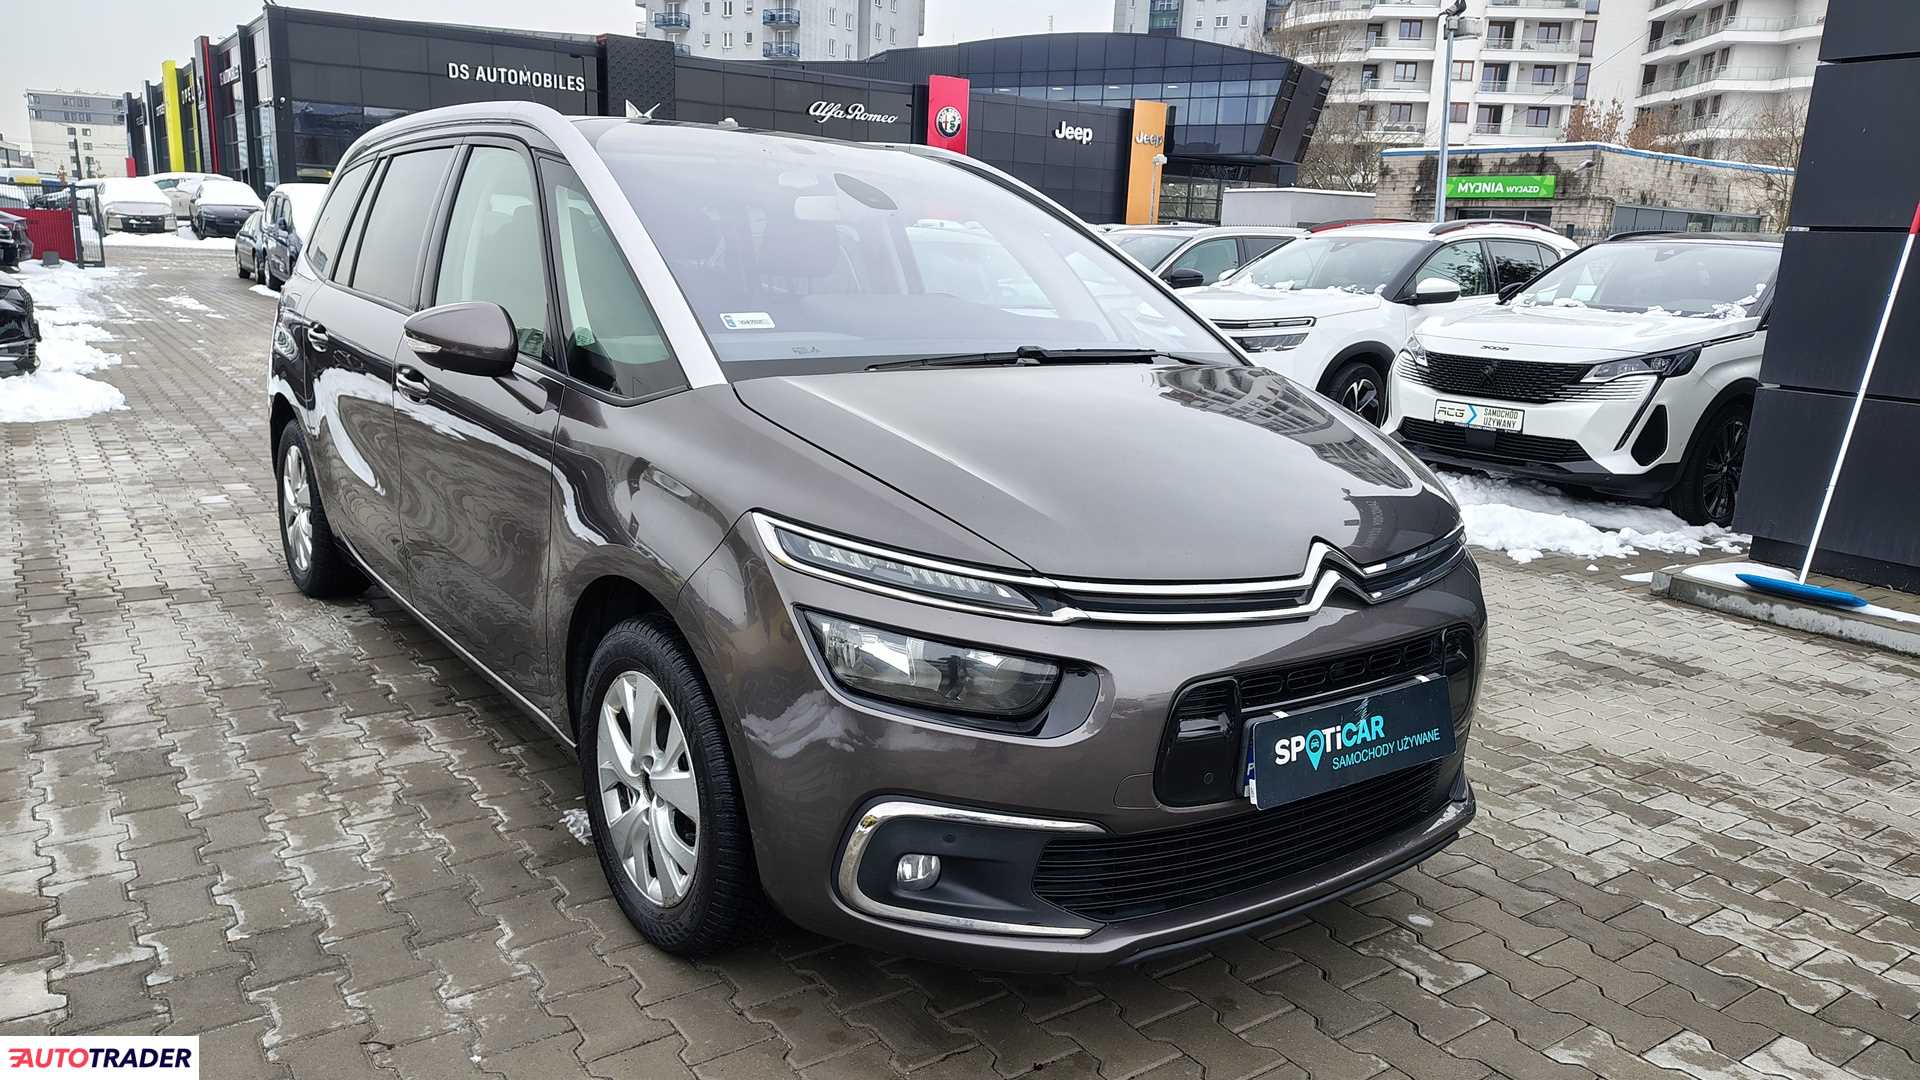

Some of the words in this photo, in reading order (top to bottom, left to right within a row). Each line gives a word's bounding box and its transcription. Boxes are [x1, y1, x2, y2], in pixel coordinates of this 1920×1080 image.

[448, 62, 470, 80] DS
[475, 65, 585, 92] AUTOMOBILES
[808, 101, 846, 123] Alfa
[847, 103, 898, 124] Romeo
[1055, 120, 1093, 145] Jeep
[1135, 131, 1164, 147] Jeep
[1457, 182, 1504, 193] MYJNIA
[1506, 185, 1540, 193] WYJAZD
[1332, 744, 1395, 770] SAMOCHODY
[1397, 728, 1441, 751] UŻYWANE
